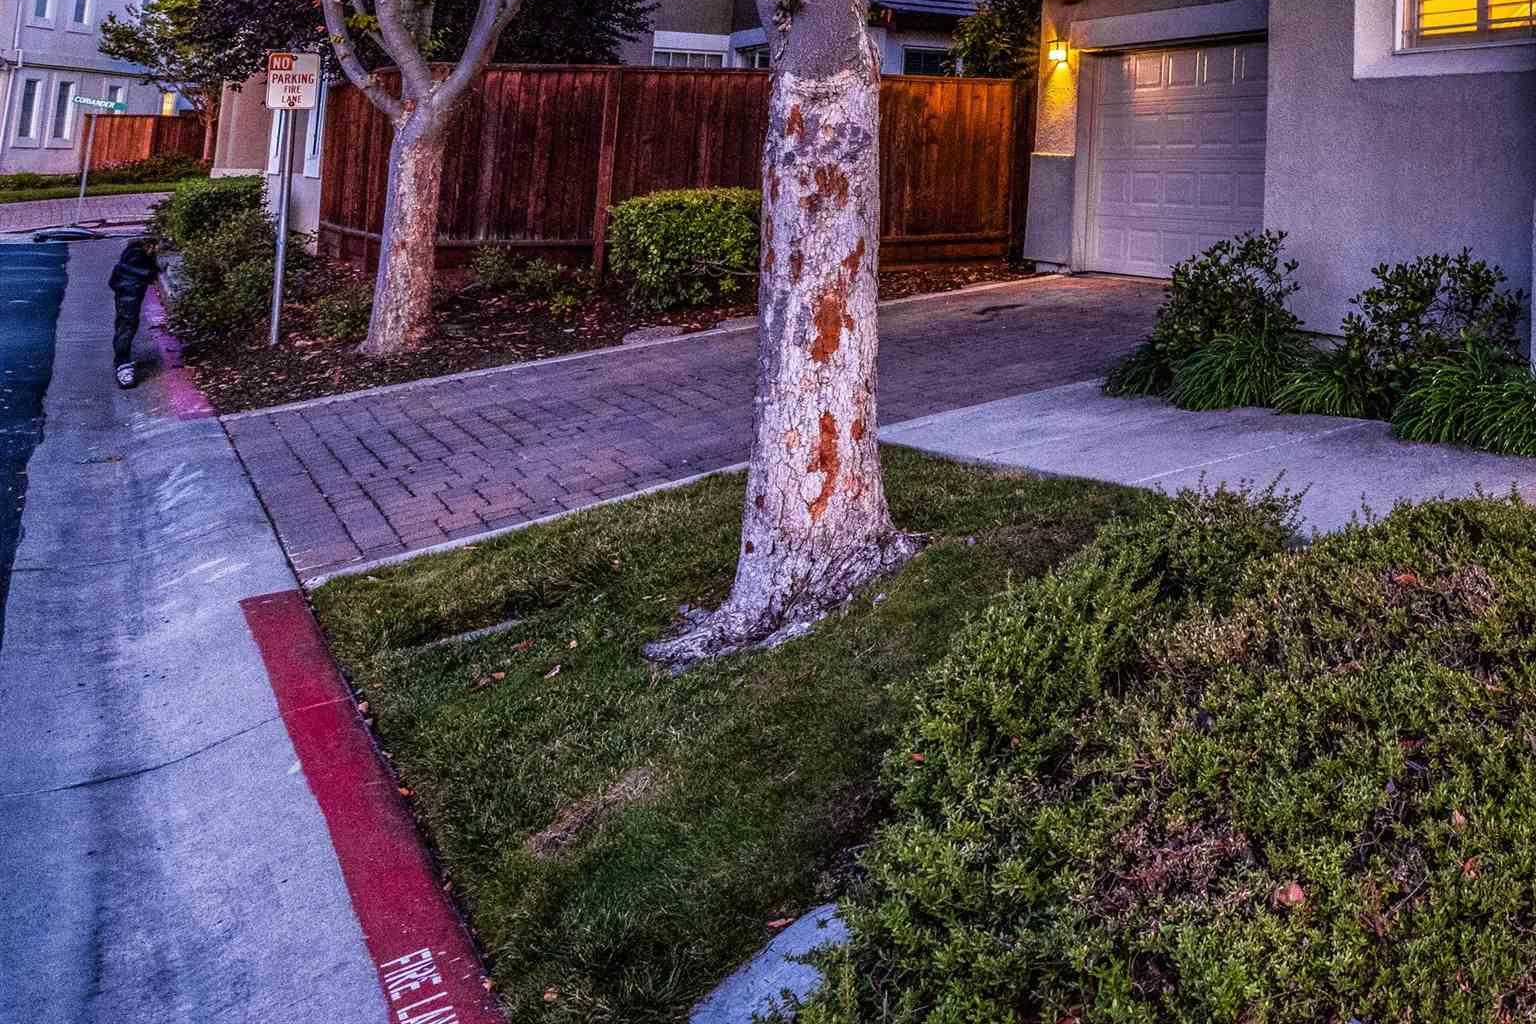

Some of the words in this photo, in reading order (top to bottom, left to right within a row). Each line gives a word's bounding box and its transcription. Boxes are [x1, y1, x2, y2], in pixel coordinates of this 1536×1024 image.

[272, 57, 290, 70] NO
[272, 73, 315, 85] PARKING
[284, 85, 303, 94] FIRE
[281, 95, 303, 104] LANE
[380, 947, 443, 1001] FIRE
